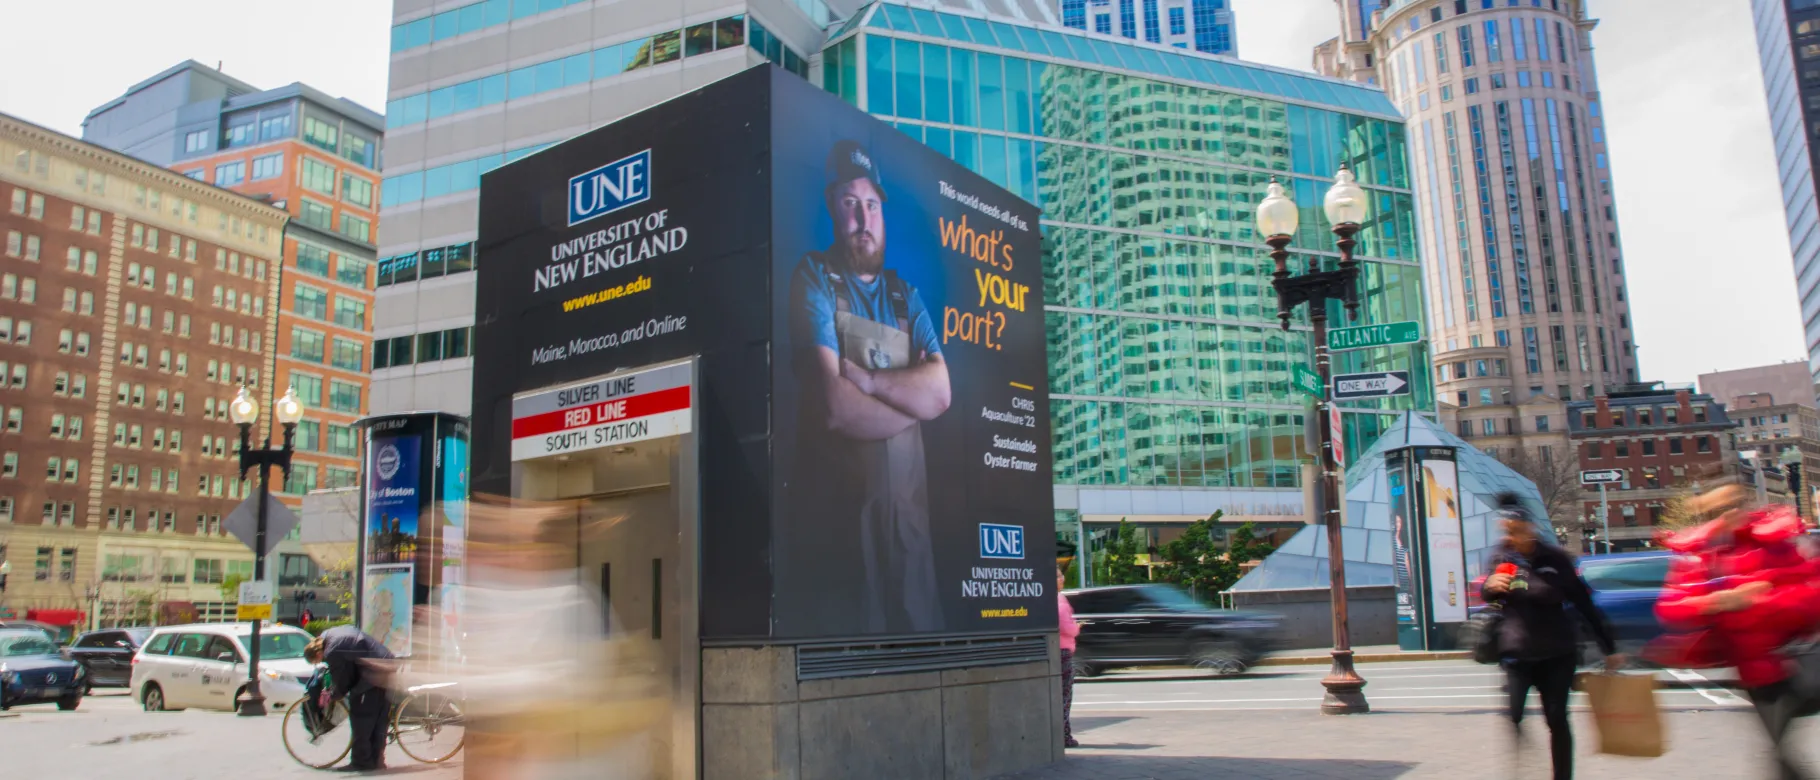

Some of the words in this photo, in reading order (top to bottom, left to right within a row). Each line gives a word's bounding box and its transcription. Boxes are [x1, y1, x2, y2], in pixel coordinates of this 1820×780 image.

[573, 158, 644, 216] UNE
[938, 180, 956, 200] This
[956, 192, 979, 209] world
[979, 202, 1001, 219] needs
[1000, 210, 1010, 223] all
[1010, 215, 1019, 228] of
[551, 217, 642, 262] UNIVERSITY
[645, 209, 668, 230] OF
[533, 255, 579, 292] NEW
[582, 226, 687, 278] ENGLAND
[562, 275, 652, 312] www.une.edu
[975, 268, 1029, 312] your
[532, 346, 567, 366] Maine,
[568, 332, 619, 357] Morocco,
[621, 322, 644, 344] and
[646, 315, 687, 338] Online
[943, 305, 1006, 351] part?
[1332, 326, 1392, 347] ATLANTIC
[1404, 331, 1417, 340] AVE
[558, 385, 600, 407] SILVER
[606, 377, 635, 397] LINE
[1340, 382, 1361, 391] ONE
[1366, 379, 1387, 388] WAY
[565, 407, 591, 428] RED
[597, 400, 627, 422] LINE
[981, 406, 1024, 425] Aquaculture
[1024, 415, 1035, 428] '22
[1012, 396, 1035, 412] CHRIS
[546, 431, 587, 452] SOUTH
[595, 420, 648, 444] STATION
[993, 434, 1036, 454] Sustainable
[984, 452, 1010, 468] Oyster
[385, 487, 415, 497] Boston
[982, 528, 1021, 554] UNE
[971, 566, 1022, 580] UNIVERSITY
[1022, 568, 1034, 580] OF
[962, 580, 989, 597] NEW
[991, 580, 1043, 597] ENGLAND
[981, 606, 1028, 618] www.une.edu
